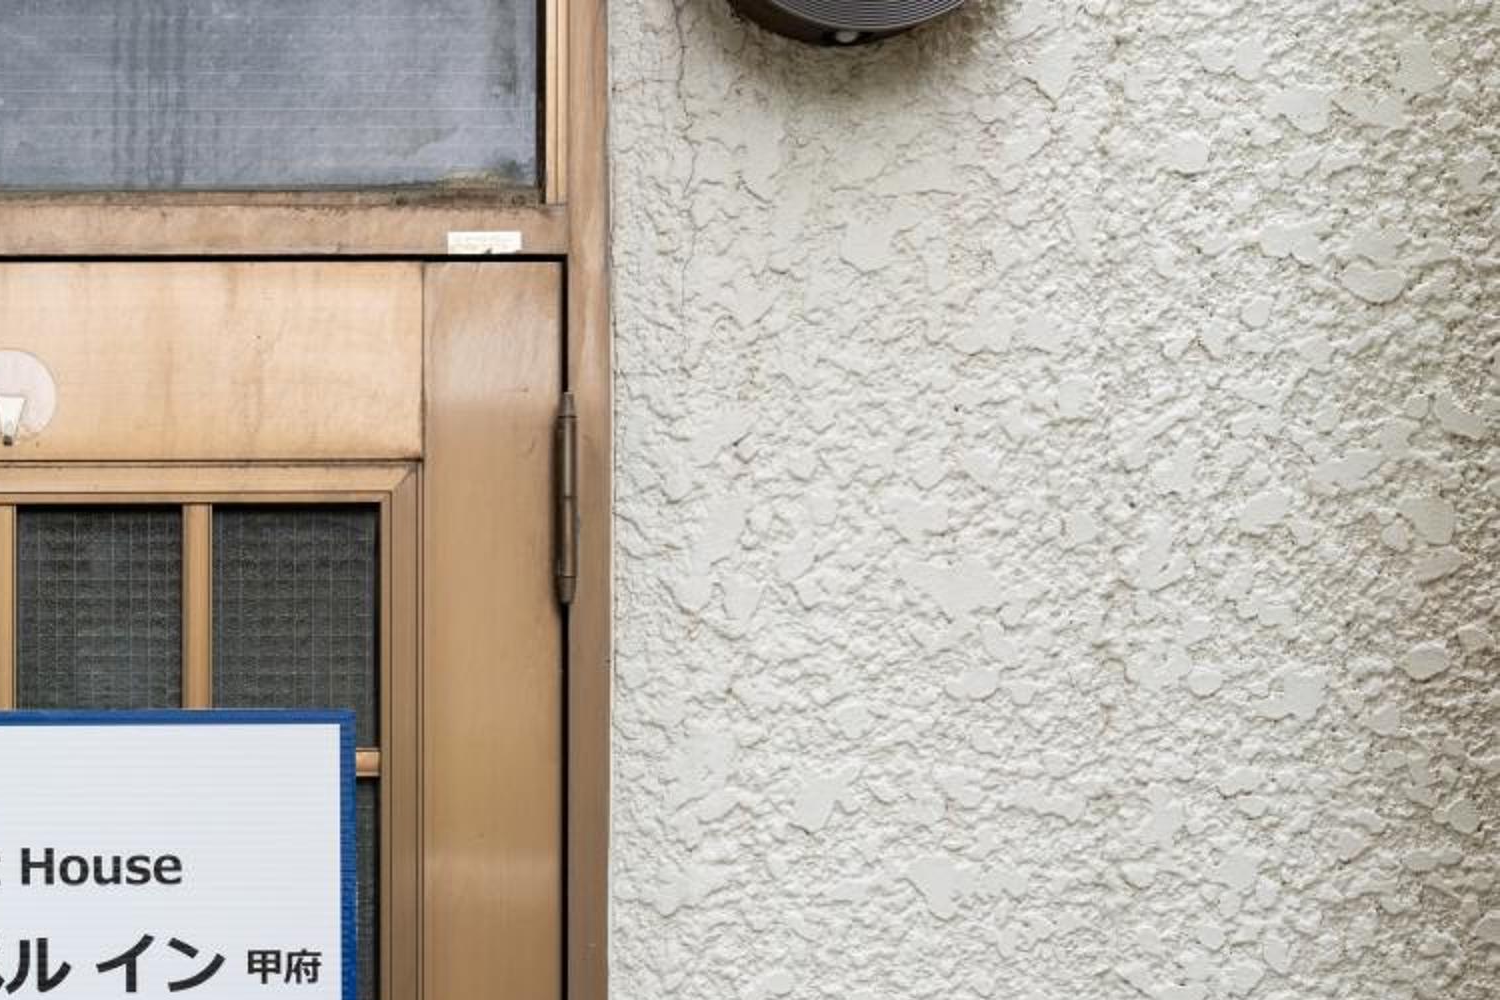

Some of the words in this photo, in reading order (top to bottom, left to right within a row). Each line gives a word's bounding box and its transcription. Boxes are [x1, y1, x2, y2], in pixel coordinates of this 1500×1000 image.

[21, 847, 183, 886] House
[95, 933, 226, 993] イン
[246, 948, 322, 985] 甲府
